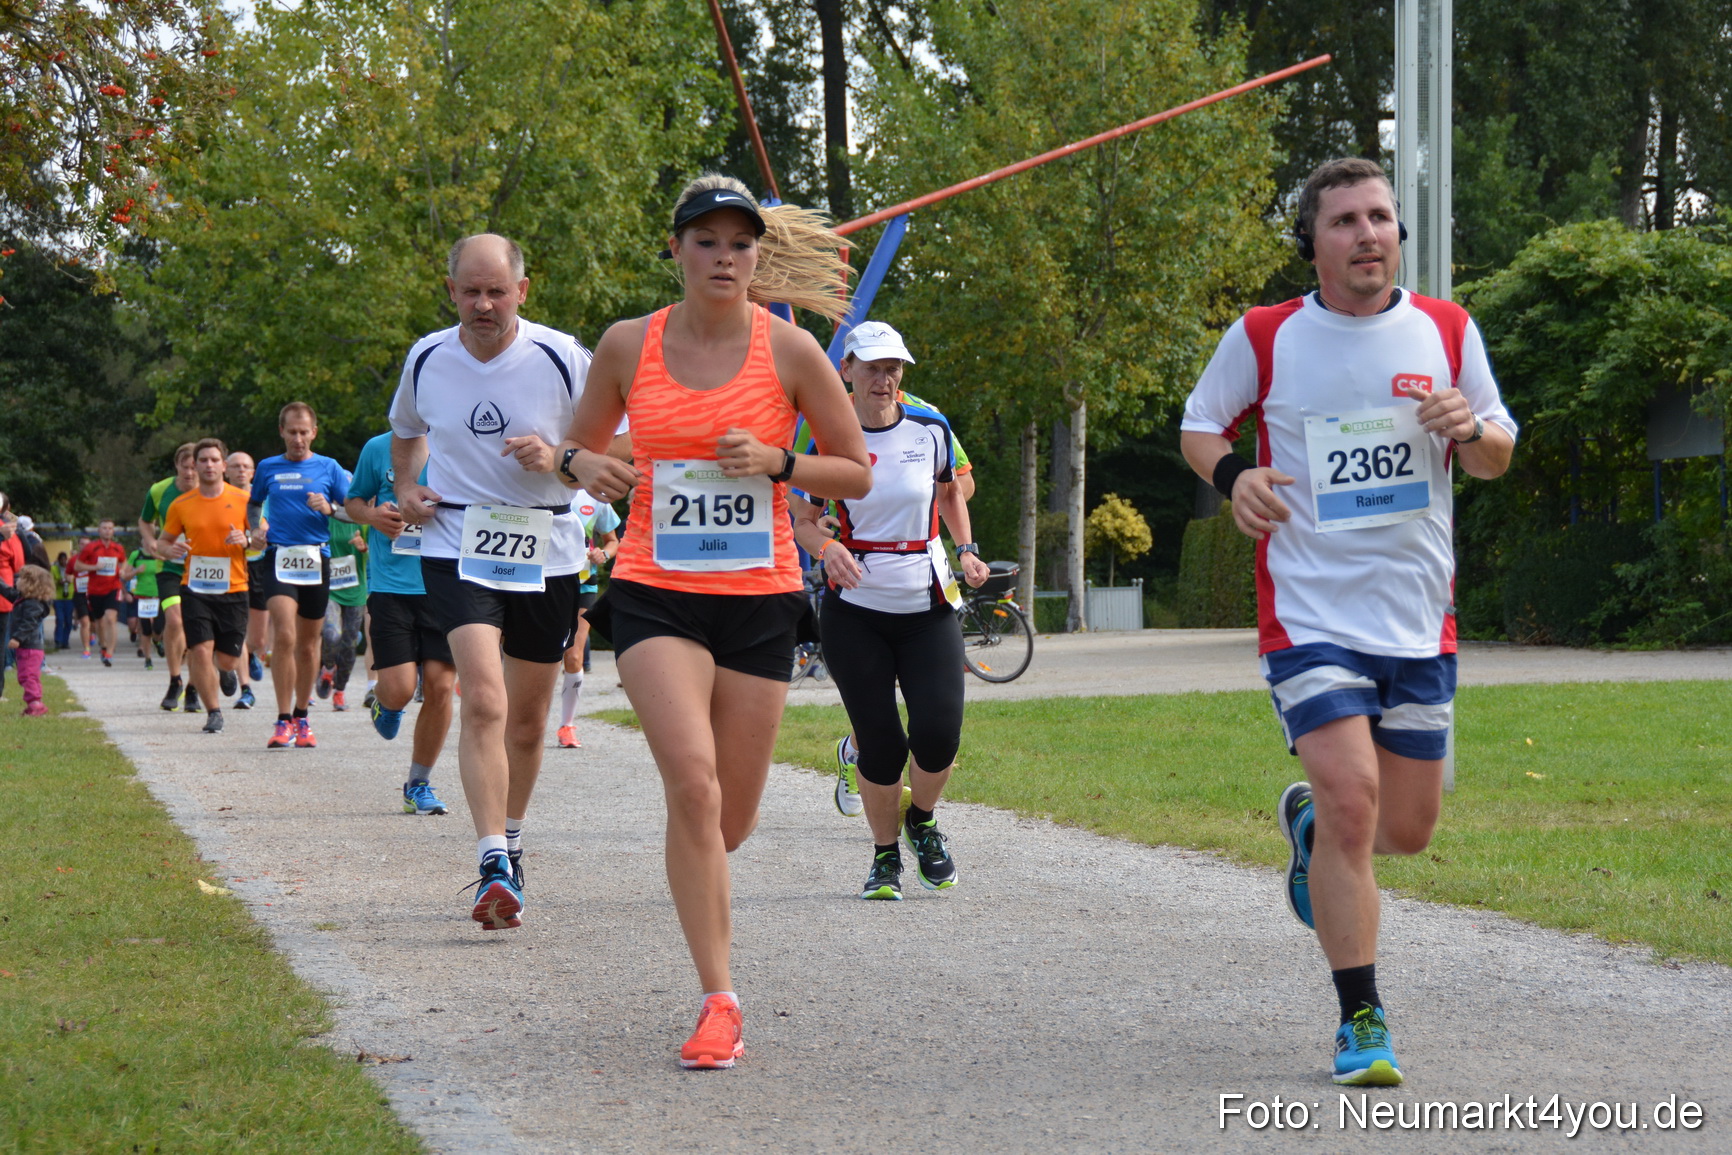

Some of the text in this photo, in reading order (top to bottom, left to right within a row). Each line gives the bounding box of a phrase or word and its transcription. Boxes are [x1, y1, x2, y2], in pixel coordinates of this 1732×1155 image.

[1397, 379, 1428, 393] CSC
[1352, 418, 1394, 432] BOCK
[1327, 442, 1414, 486] 2362
[1356, 493, 1395, 508] Rainer
[670, 494, 754, 526] 2159
[499, 513, 529, 523] BOCK
[474, 529, 537, 559] 2273
[699, 539, 728, 551] Julia
[282, 557, 314, 569] 2412
[195, 567, 224, 579] 2120
[492, 565, 516, 576] Josef
